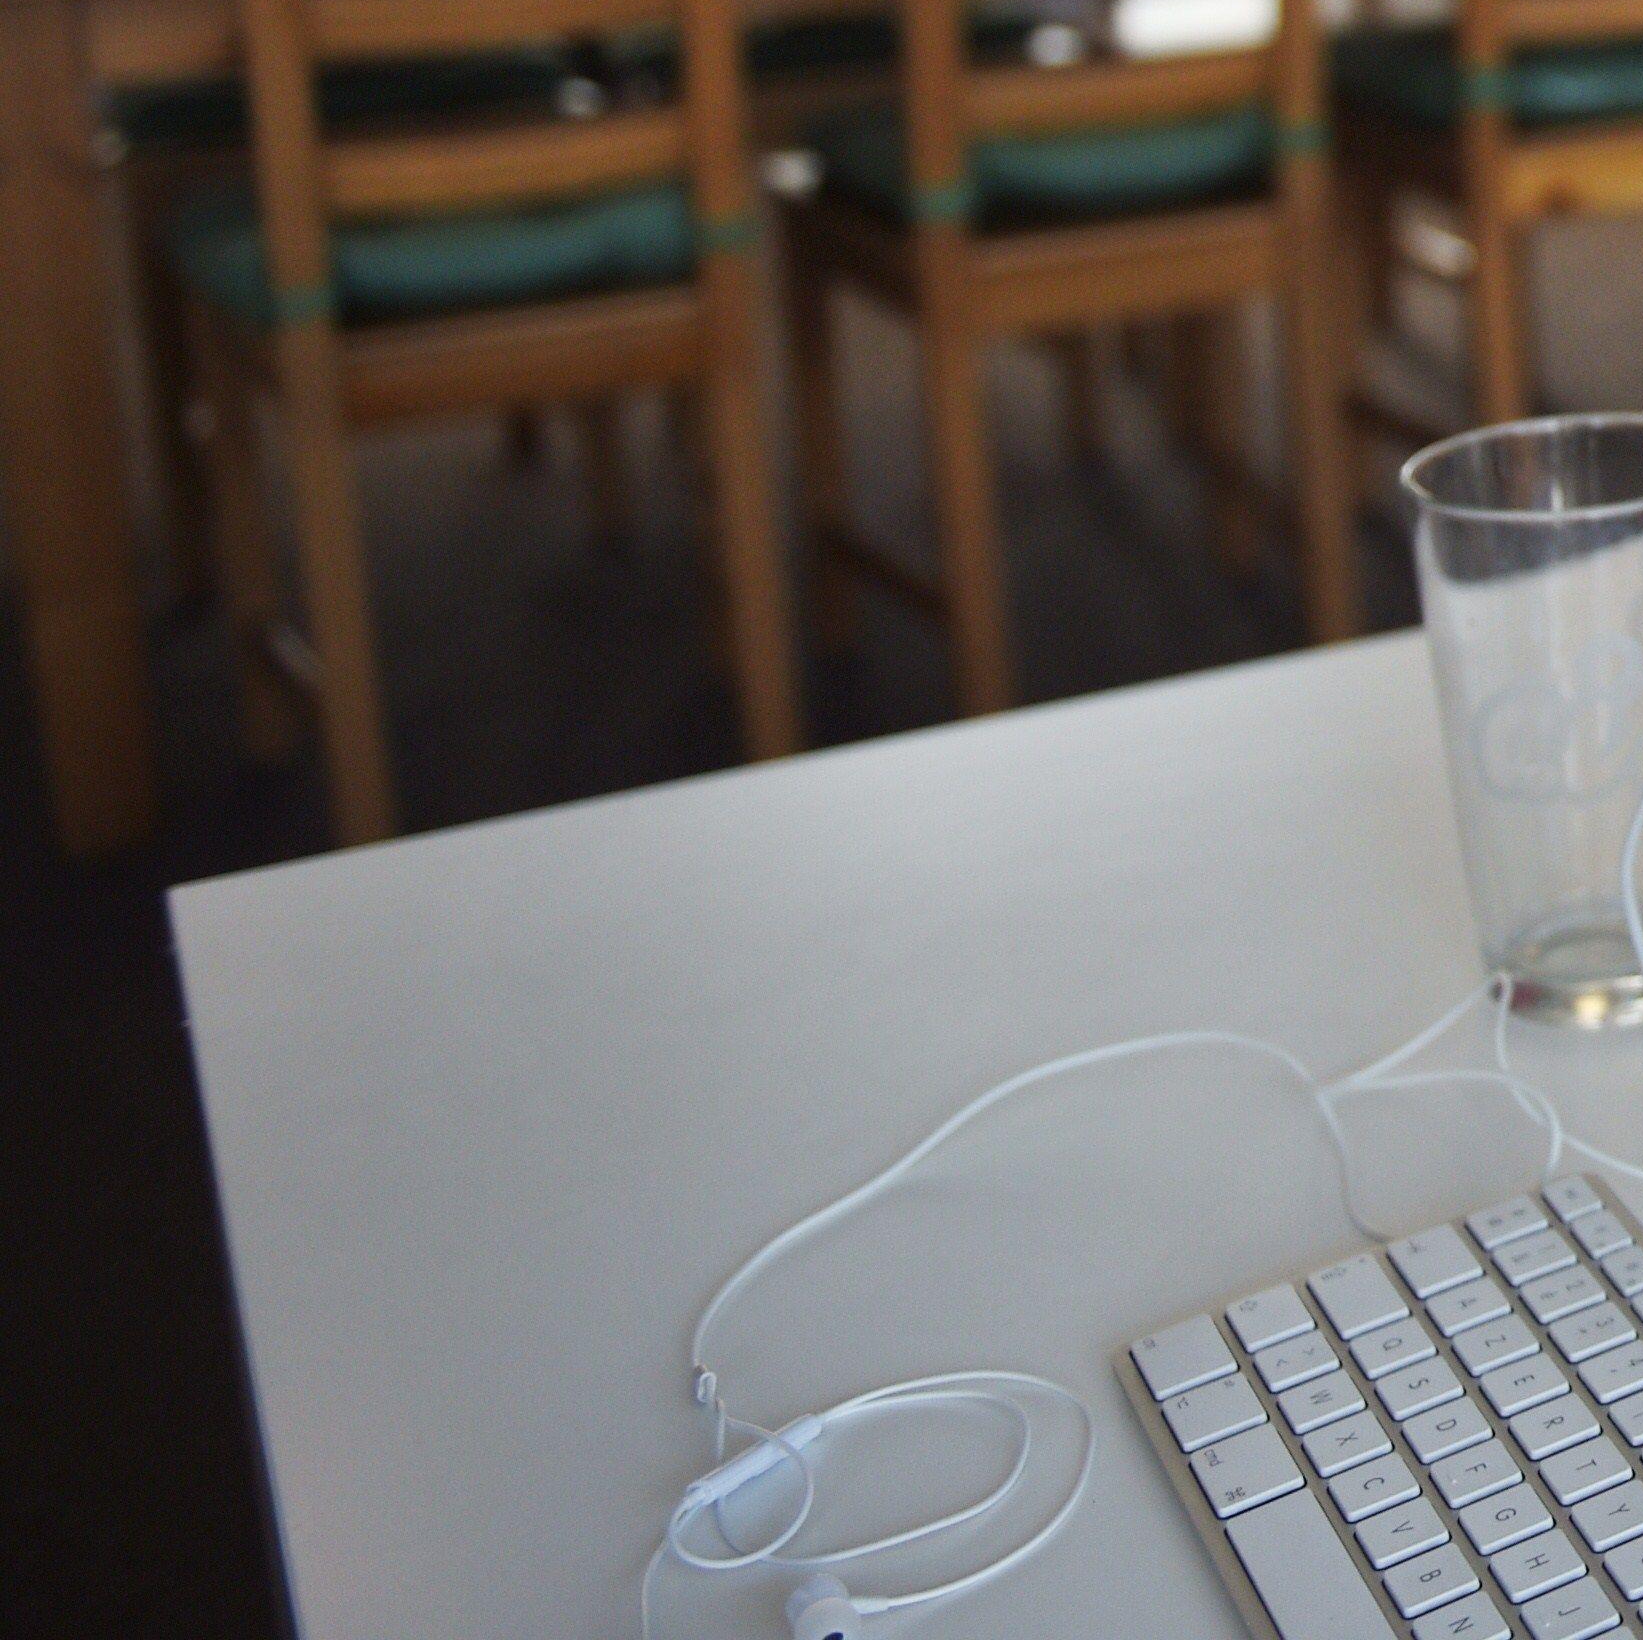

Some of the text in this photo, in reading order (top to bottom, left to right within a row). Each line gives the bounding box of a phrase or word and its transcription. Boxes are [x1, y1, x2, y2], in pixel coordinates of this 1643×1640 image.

[1460, 1296, 1478, 1309] A
[1382, 1336, 1403, 1352] Q
[1485, 1335, 1507, 1348] Z
[1408, 1377, 1430, 1390] S
[1513, 1373, 1535, 1387] E
[1310, 1389, 1332, 1405] W
[1436, 1418, 1457, 1432] D
[1544, 1416, 1565, 1429] R
[1336, 1432, 1358, 1446] X
[1465, 1462, 1487, 1474] F
[1576, 1458, 1598, 1471] T
[1363, 1477, 1385, 1491] C
[1495, 1507, 1517, 1521] G
[1608, 1502, 1630, 1516] Y
[1391, 1520, 1414, 1535] V
[1525, 1553, 1550, 1570] H
[1419, 1568, 1442, 1584] B
[1558, 1606, 1581, 1618] J
[1448, 1617, 1474, 1633] N
